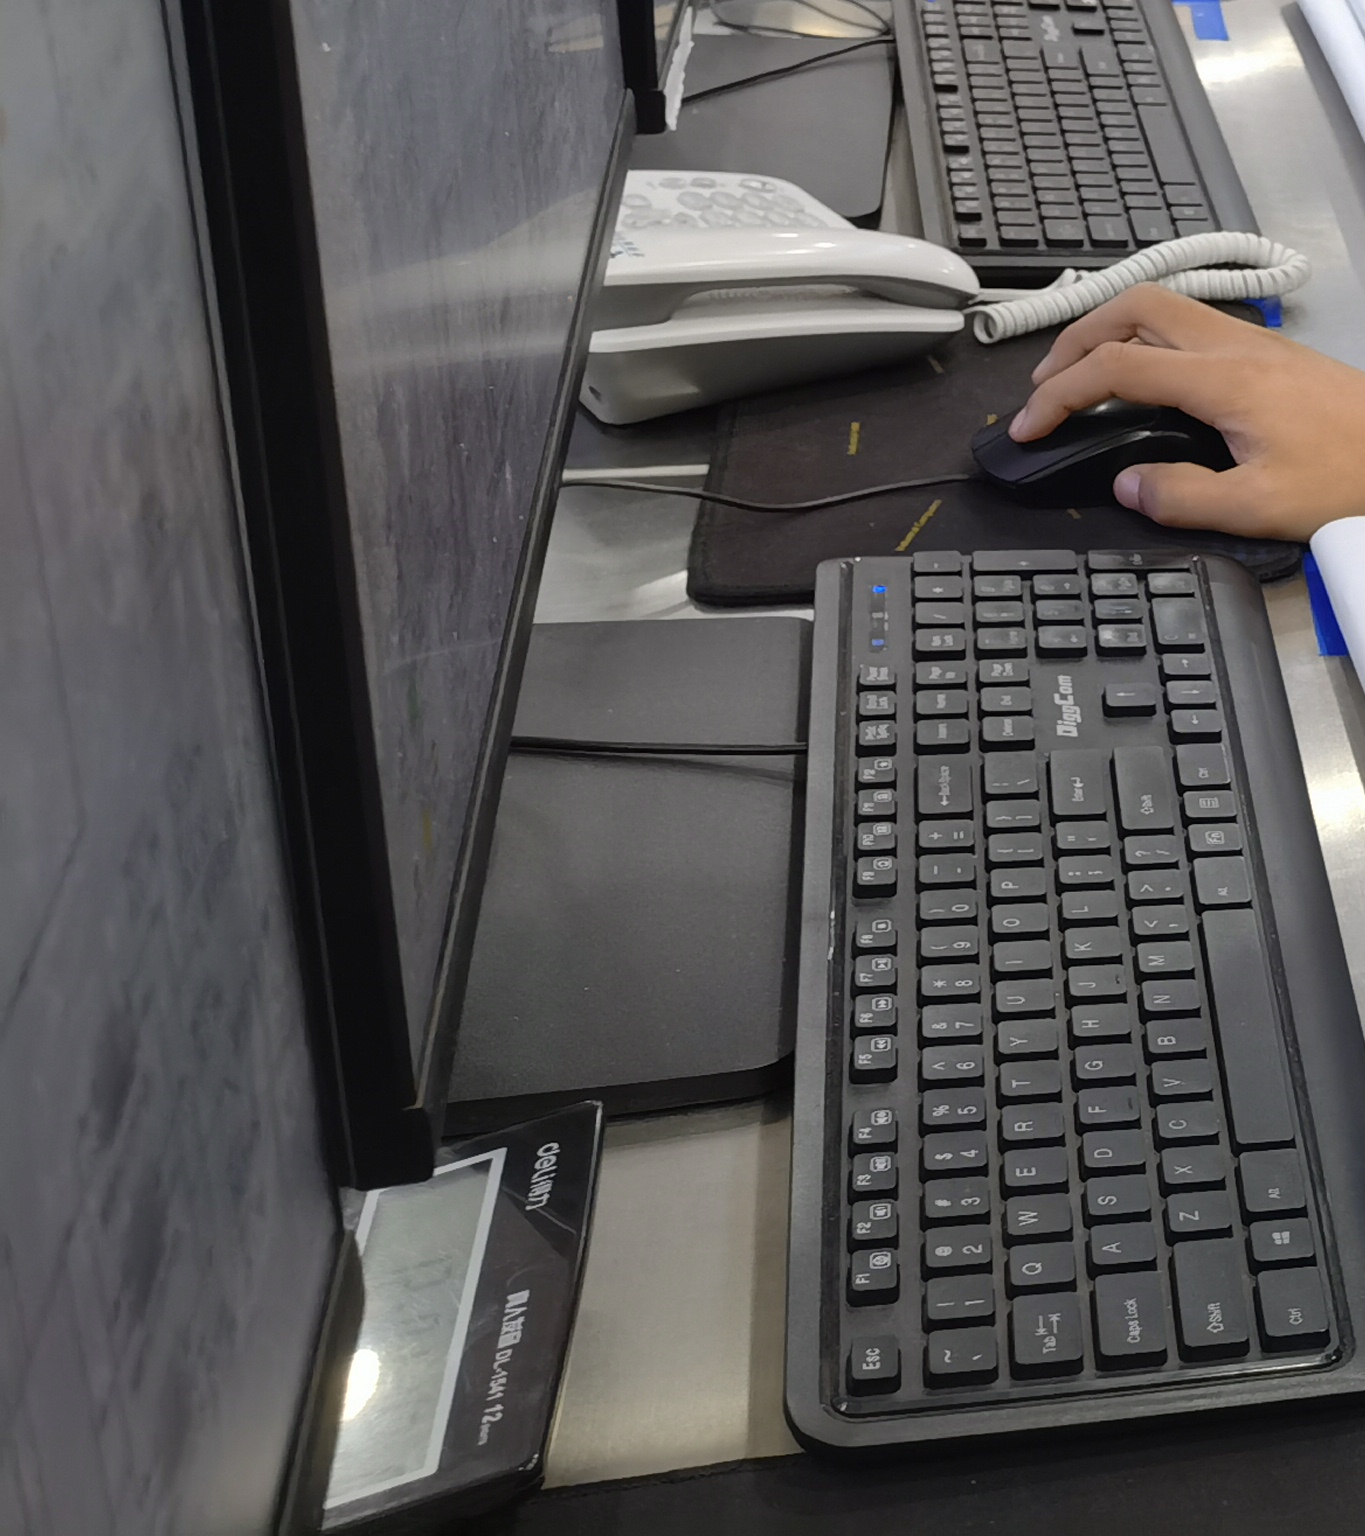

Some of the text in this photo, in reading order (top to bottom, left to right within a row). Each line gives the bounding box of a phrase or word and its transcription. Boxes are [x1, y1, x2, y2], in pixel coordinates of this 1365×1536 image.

[1054, 676, 1081, 737] DiggCom
[1003, 919, 1020, 927] O
[1075, 942, 1092, 951] K
[1148, 956, 1164, 965] M
[1007, 996, 1025, 1004] U
[1082, 1020, 1099, 1028] H
[1010, 1038, 1028, 1046] Y
[1158, 1036, 1176, 1045] B
[858, 1054, 872, 1064] F5
[1085, 1061, 1102, 1070] G
[1012, 1080, 1030, 1088] T
[1163, 1078, 1181, 1087] V
[958, 1106, 976, 1114] 5
[1014, 1122, 1033, 1131] R
[1169, 1120, 1186, 1129] C
[858, 1128, 872, 1138] F4
[1094, 1148, 1112, 1158] D
[1016, 1167, 1036, 1176] E
[1175, 1166, 1192, 1174] X
[961, 1198, 980, 1206] 3
[1098, 1196, 1116, 1204] S
[1018, 1212, 1038, 1226] W
[1180, 1211, 1199, 1221] Z
[857, 1222, 871, 1234] F2
[962, 1244, 982, 1254] 2
[1102, 1242, 1121, 1252] A
[1022, 1263, 1042, 1275] Q
[856, 1274, 870, 1284] F1
[1124, 1298, 1142, 1343] Caps Lock
[1288, 1308, 1303, 1324] Ctrl
[1043, 1336, 1056, 1354] Tab
[863, 1348, 880, 1370] Esc
